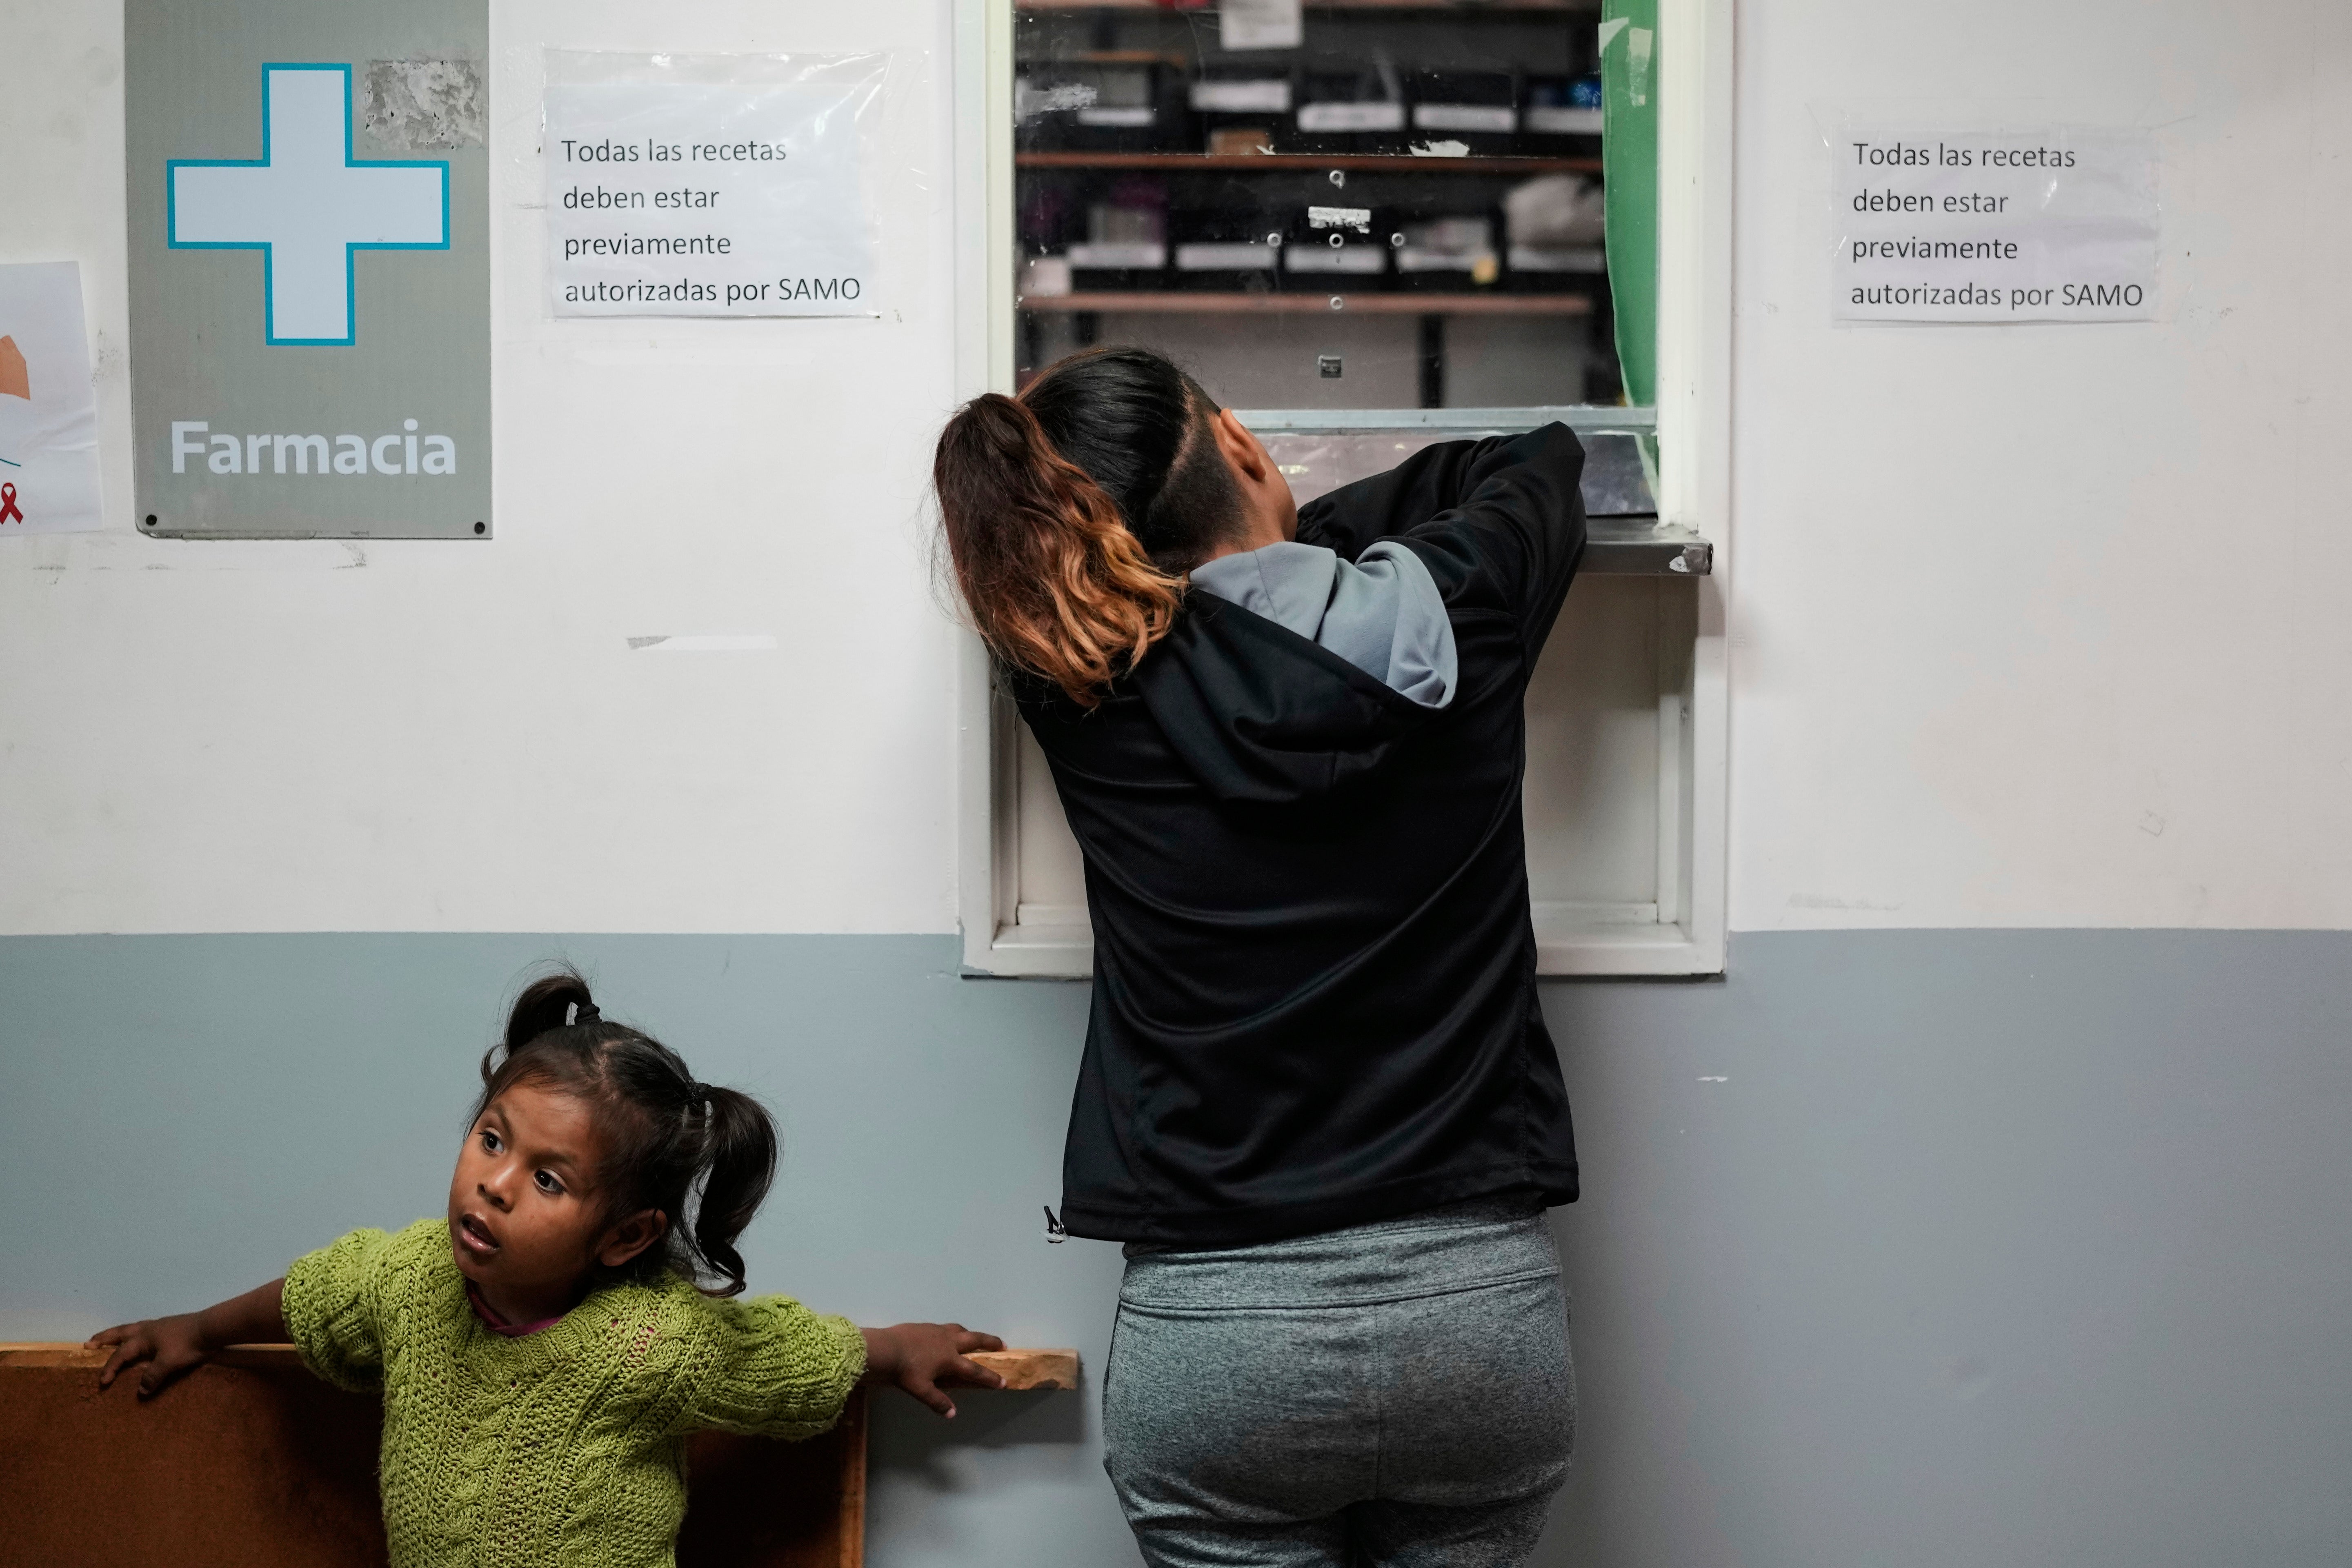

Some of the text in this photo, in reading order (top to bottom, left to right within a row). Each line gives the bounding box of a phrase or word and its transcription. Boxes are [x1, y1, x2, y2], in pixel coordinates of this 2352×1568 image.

[561, 138, 786, 162] Todas las recetas
[1853, 142, 2075, 167] Todas las recetas
[563, 185, 720, 209] deben estar
[1853, 188, 2009, 213] deben estar
[565, 232, 731, 261] previamente
[1853, 236, 2017, 263] previamente
[565, 278, 860, 307] autorizadas por SAMO
[1852, 282, 2143, 311] autorizadas por SAMO
[171, 418, 456, 475] Farmacia
